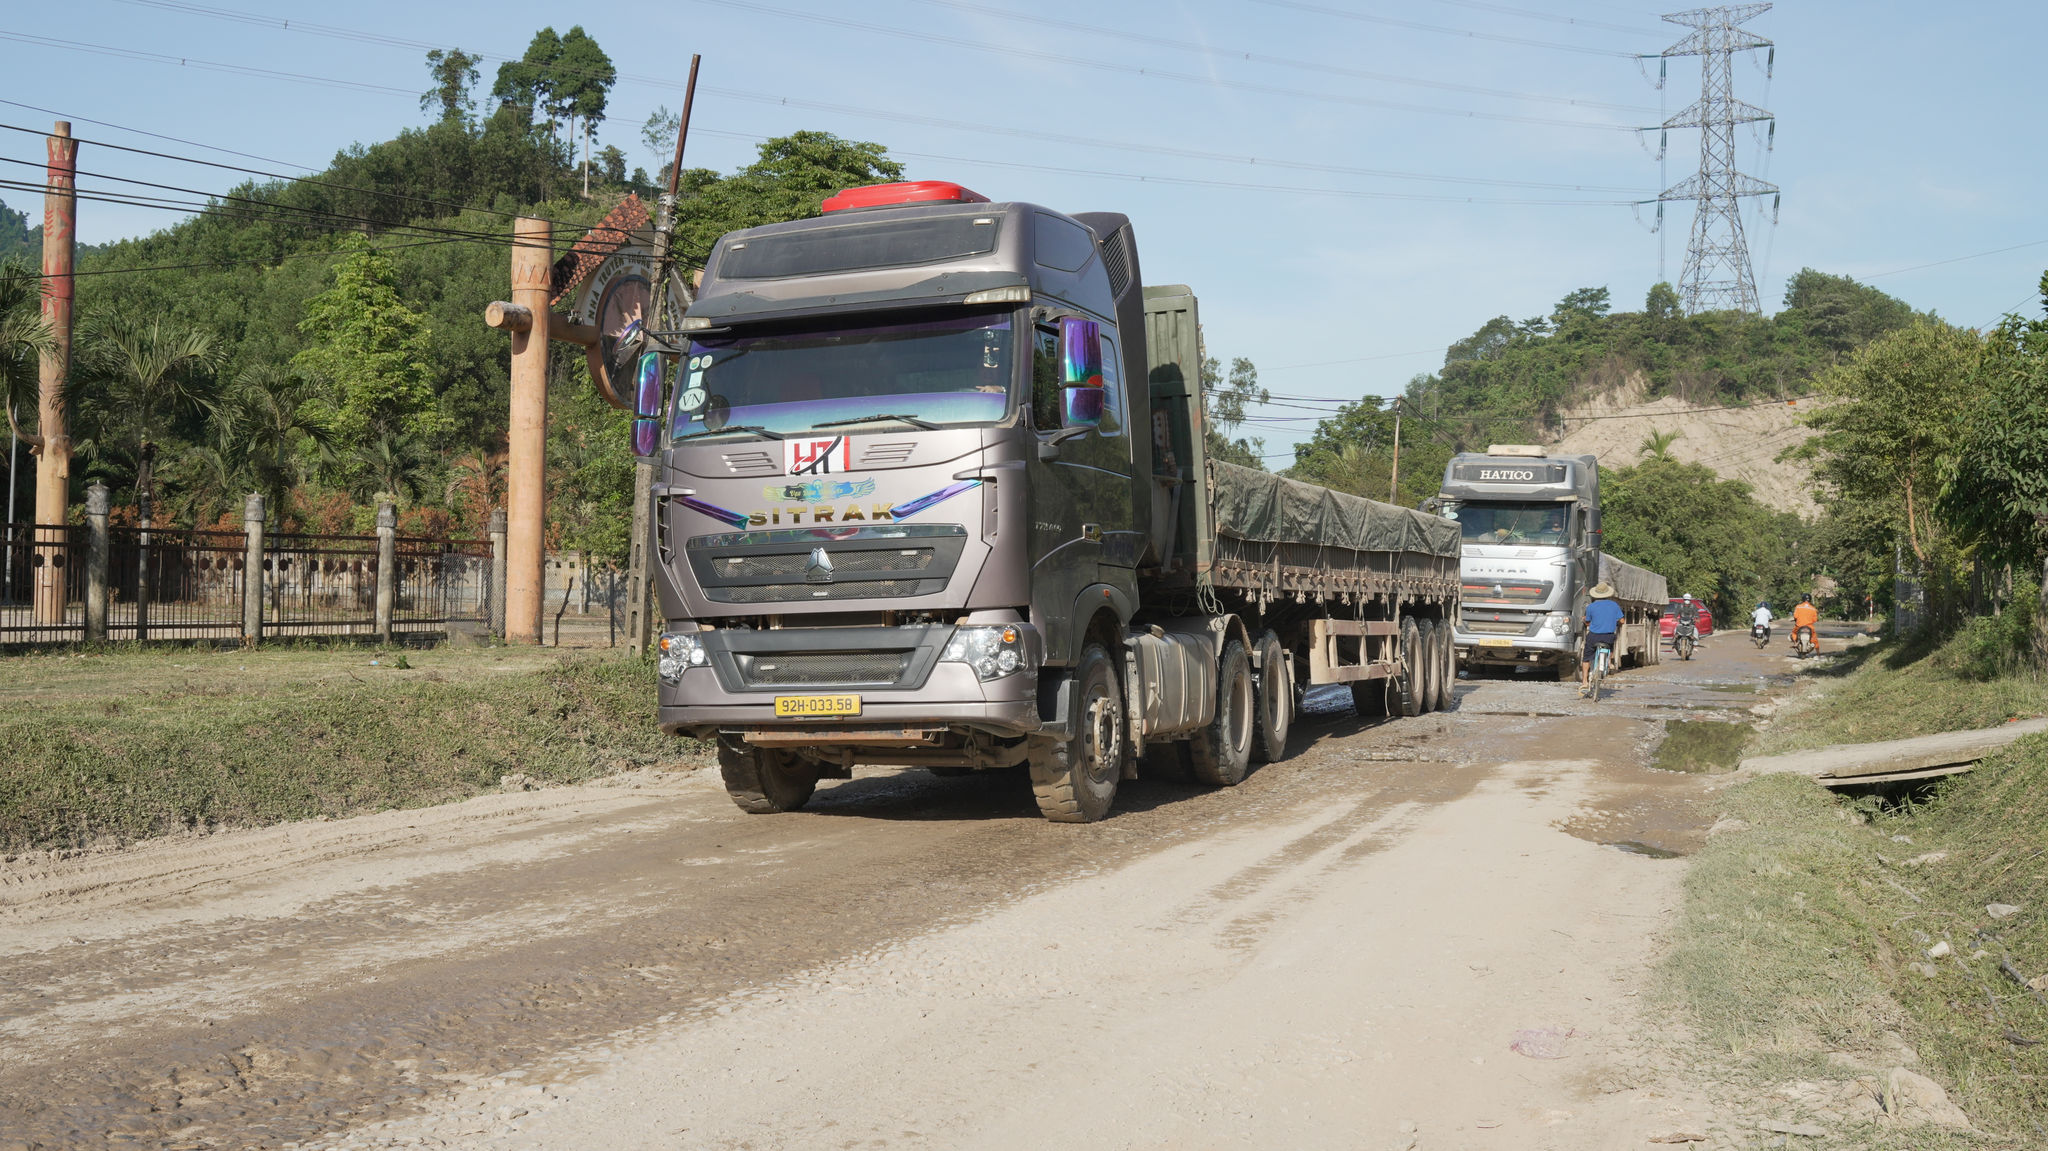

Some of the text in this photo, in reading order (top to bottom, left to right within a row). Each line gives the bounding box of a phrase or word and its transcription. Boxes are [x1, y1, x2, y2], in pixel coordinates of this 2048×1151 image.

[682, 391, 703, 407] VN
[1480, 469, 1534, 481] HATICO
[748, 502, 895, 527] SITRAK
